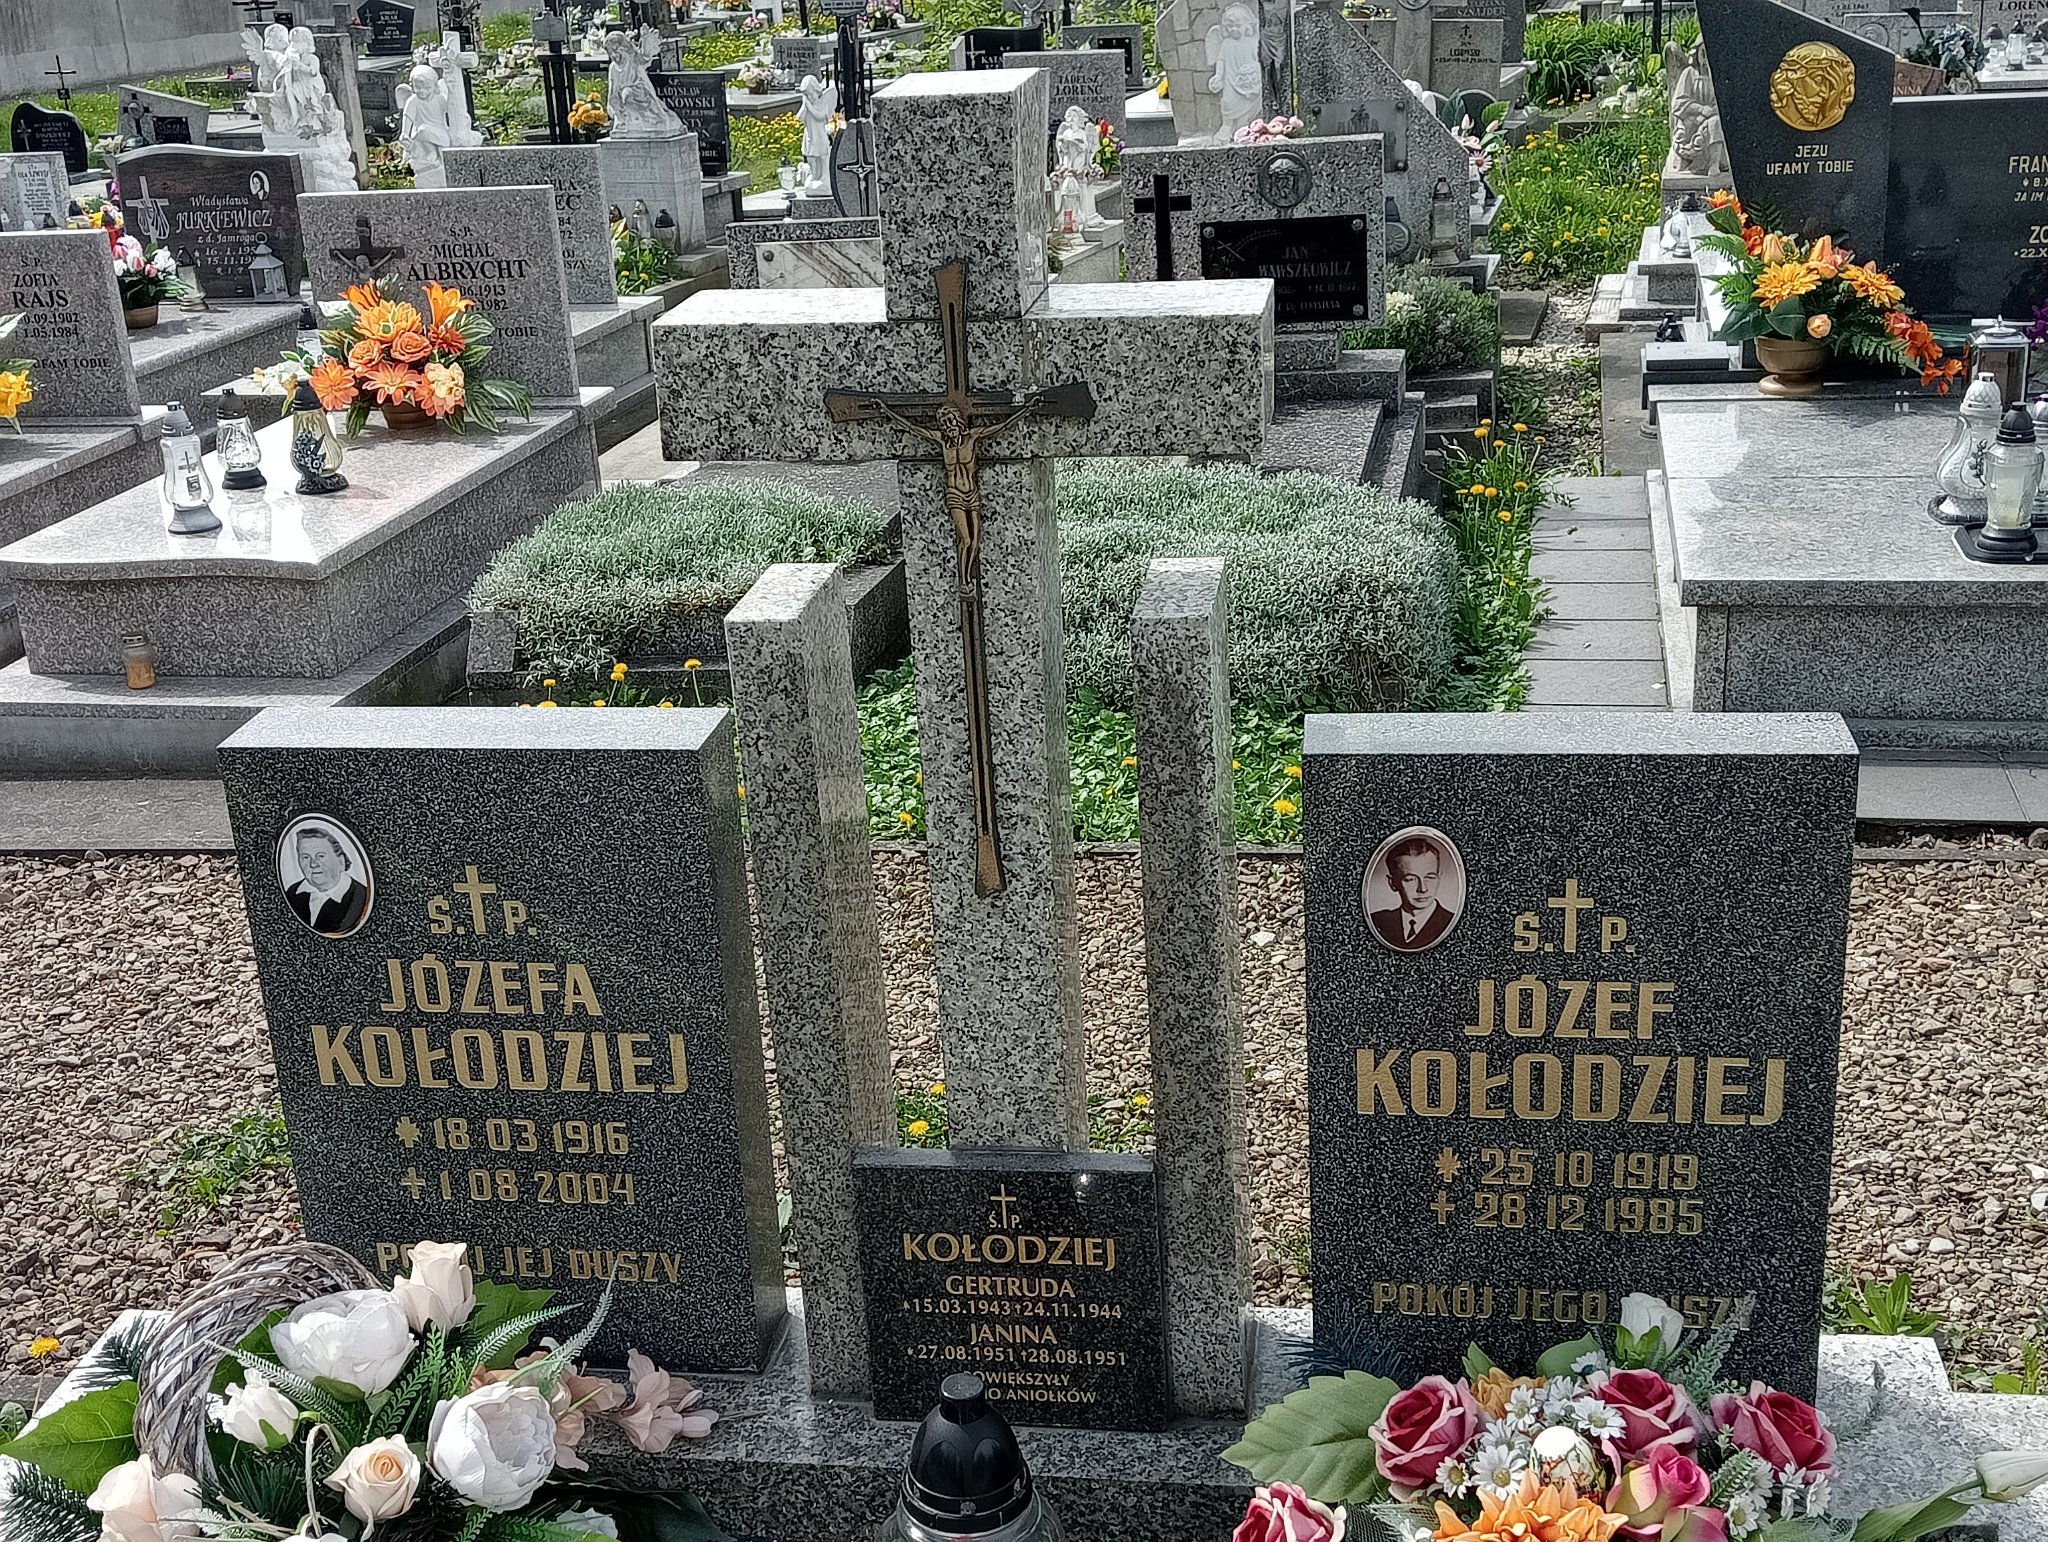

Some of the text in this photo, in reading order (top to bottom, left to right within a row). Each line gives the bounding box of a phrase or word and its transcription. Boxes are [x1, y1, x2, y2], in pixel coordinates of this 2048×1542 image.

[1766, 160, 1854, 175] UFAMY TOBIE
[1795, 145, 1828, 158] JEZU
[190, 194, 249, 210] Władysława
[2014, 191, 2044, 202] JA IM
[176, 207, 273, 233] JURKIEWICZ
[13, 273, 59, 287] ZOFIA
[407, 259, 531, 281] ALBRYCHT
[12, 289, 69, 308] RAJS
[71, 357, 111, 369] TOBIE
[428, 895, 538, 936] Ś. P.
[1513, 911, 1635, 953] Ś. P.
[380, 954, 603, 1016] JÓZEFA
[1464, 974, 1676, 1039] JÓZEF
[311, 1024, 689, 1094] KOŁODZIEJ
[1356, 1048, 1787, 1126] KOŁODZIEJ
[433, 1116, 630, 1155] 18 03 1916
[439, 1168, 634, 1205] 1 08 2004
[1481, 1148, 1699, 1190] 25 10 1919
[1474, 1191, 1704, 1235] 28 12 1985
[500, 1246, 553, 1277] JEJ
[569, 1249, 681, 1283] DUSZY
[903, 1232, 1115, 1271] KOŁODZIEJ
[946, 1276, 1075, 1298] GERTRUDA
[1373, 1281, 1494, 1319] POKÓJ
[1510, 1286, 1607, 1324] JEGO
[970, 1323, 1057, 1345] JANINA
[1007, 1387, 1096, 1403] ANIOŁKÓW
